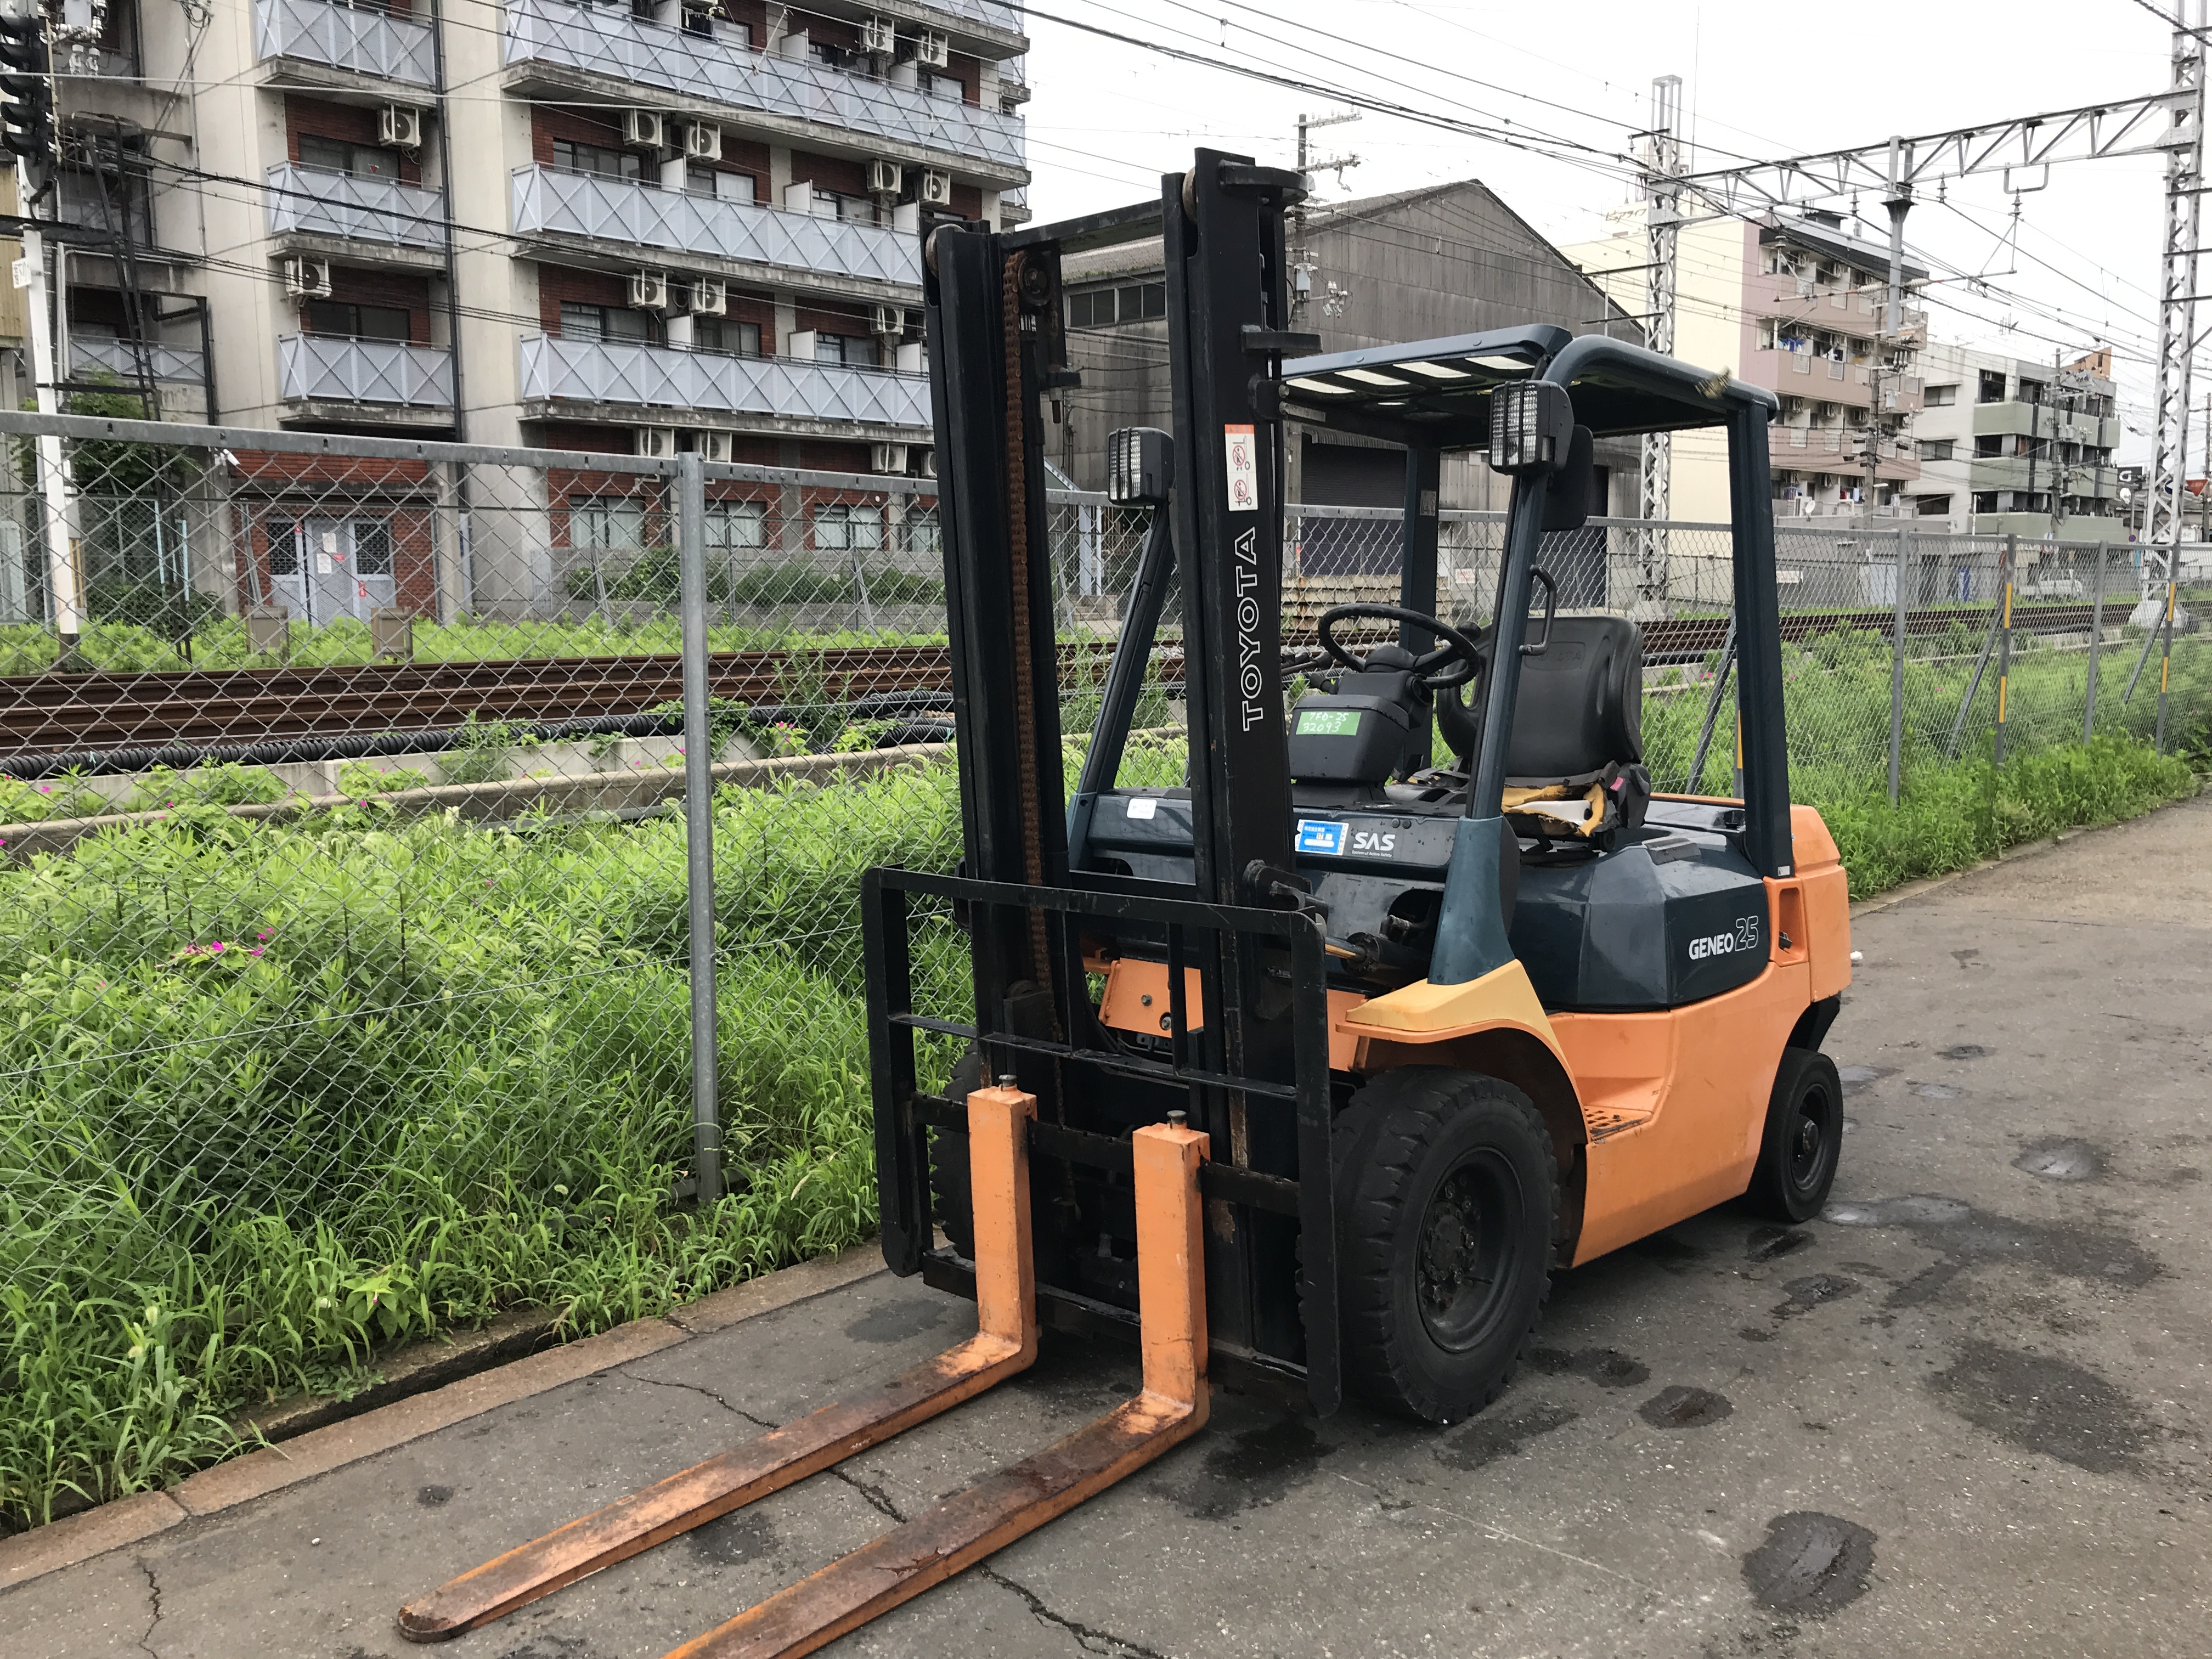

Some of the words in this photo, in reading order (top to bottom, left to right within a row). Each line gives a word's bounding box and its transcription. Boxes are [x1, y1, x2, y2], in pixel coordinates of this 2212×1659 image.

[1234, 526, 1263, 732] TOYOTA
[1302, 720, 1342, 733] 32093
[1353, 832, 1396, 851] SAS
[1689, 933, 1734, 960] GENEO
[1735, 915, 1759, 952] 25
